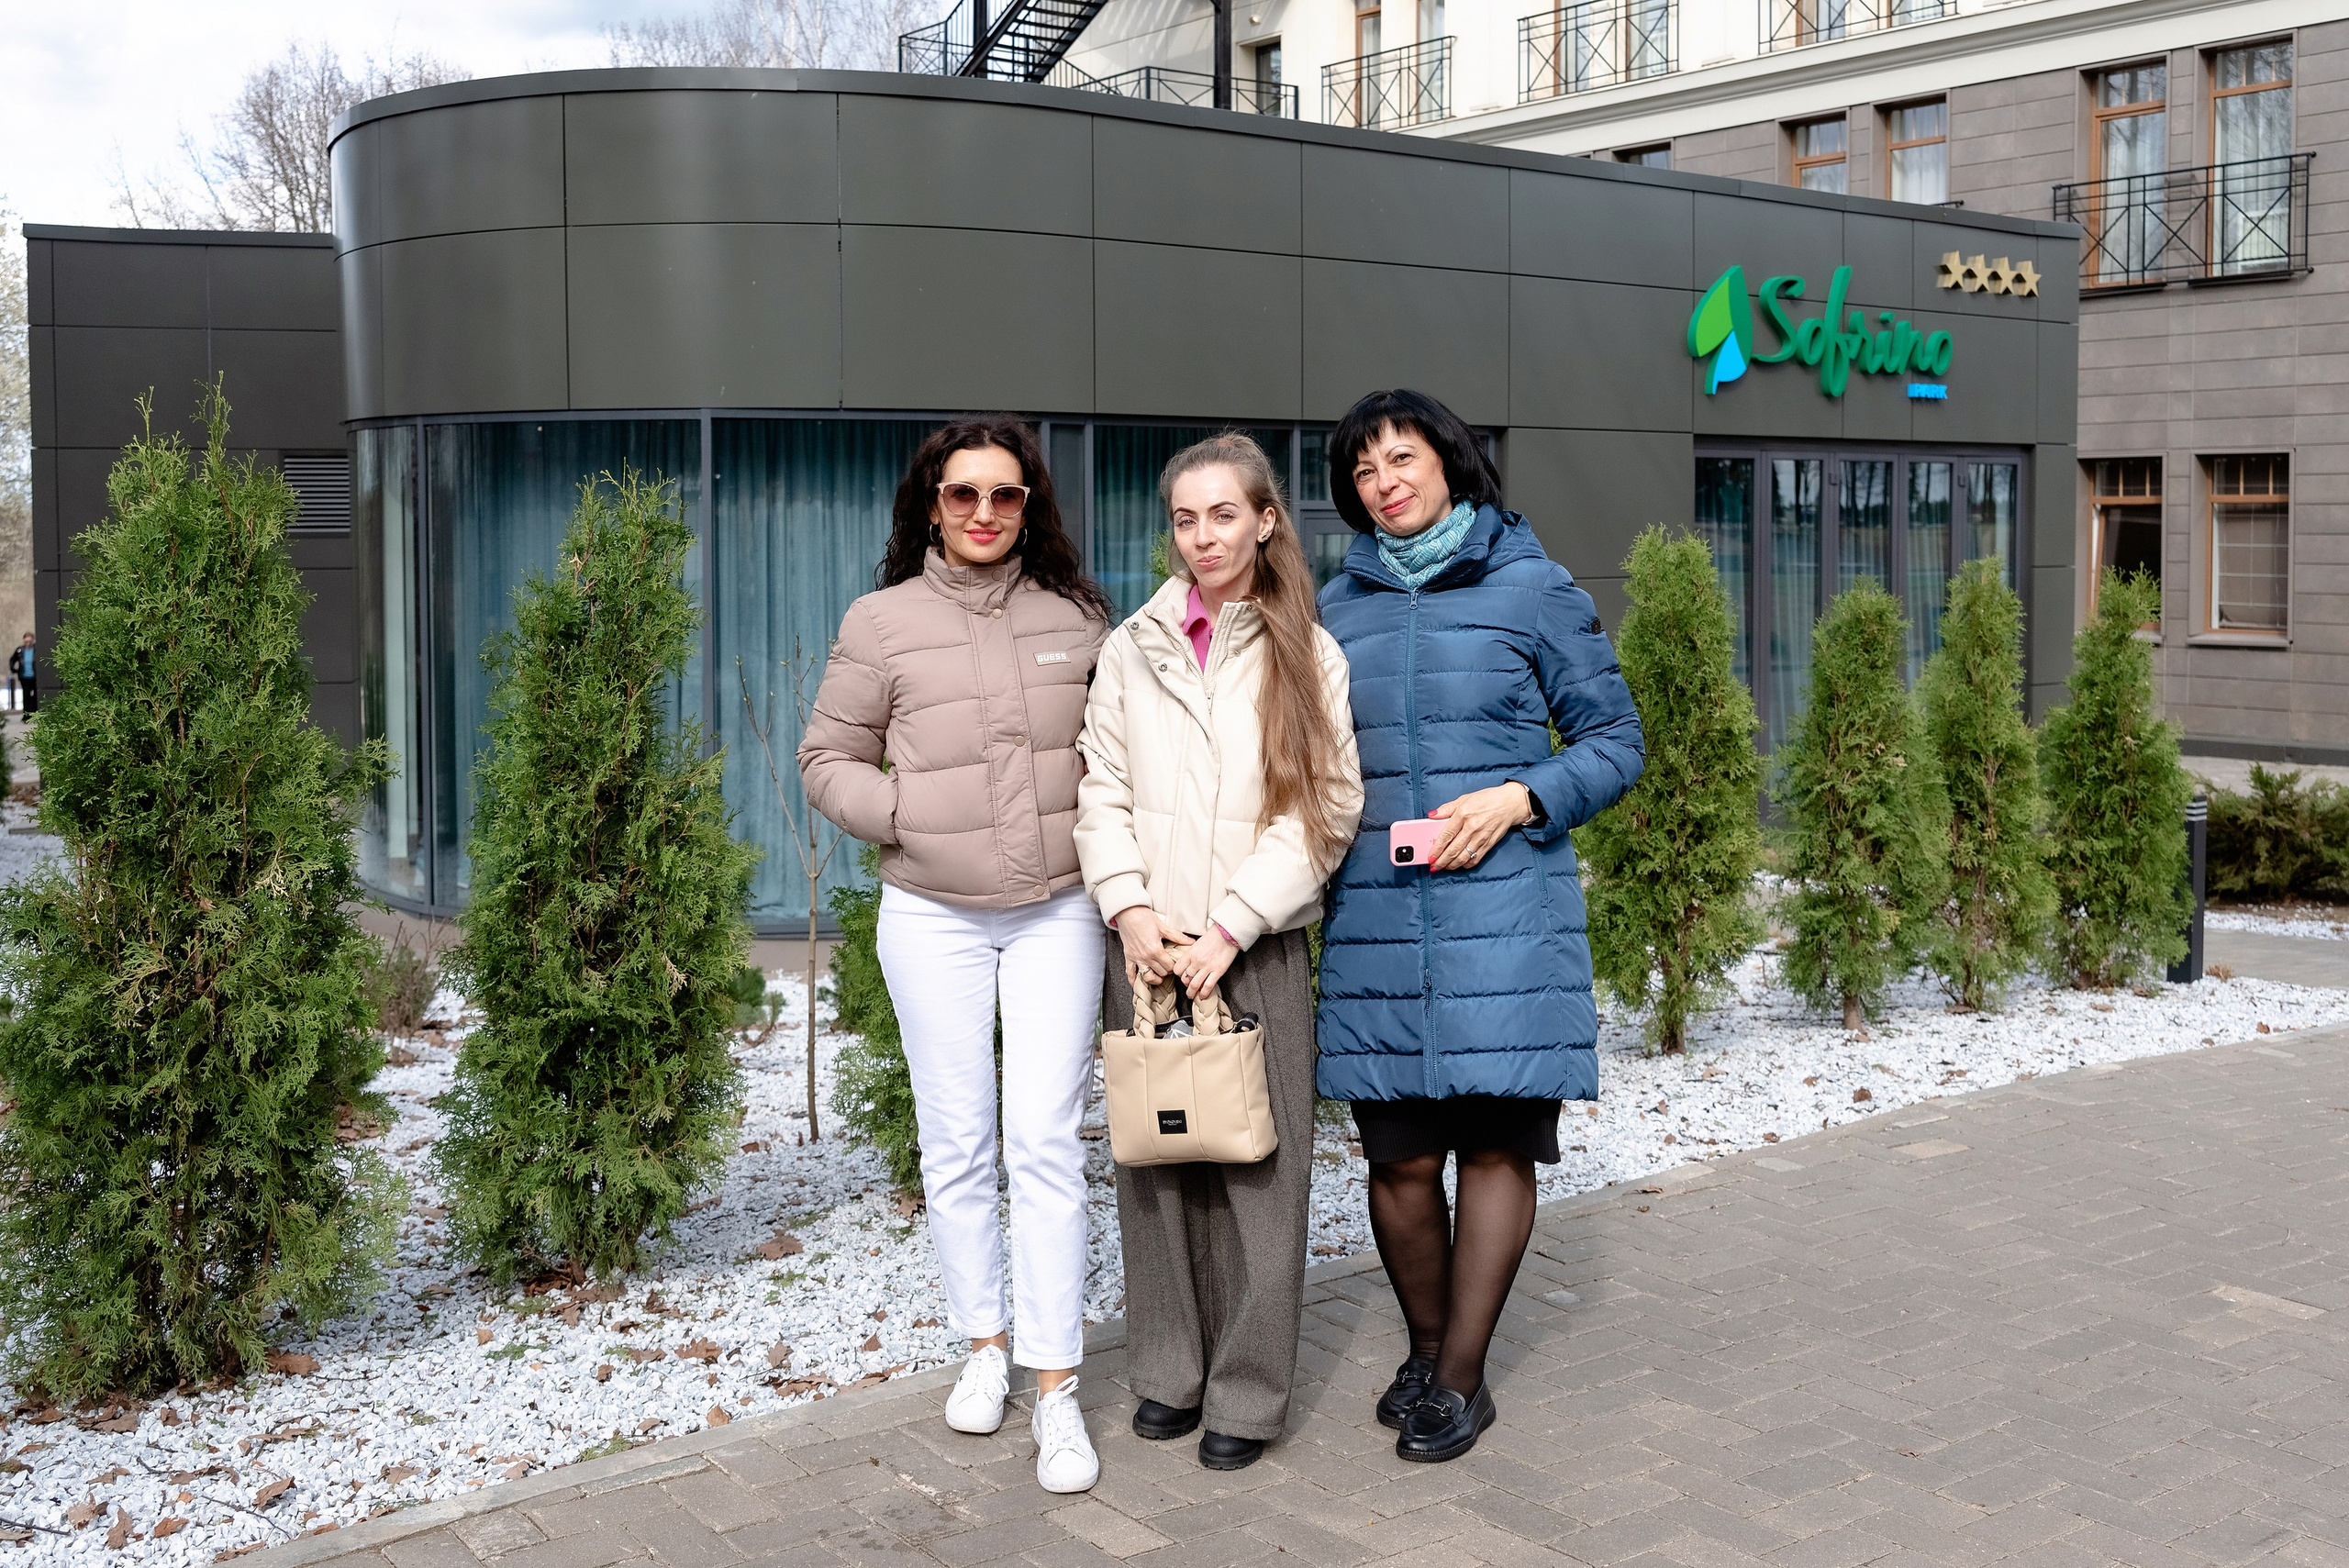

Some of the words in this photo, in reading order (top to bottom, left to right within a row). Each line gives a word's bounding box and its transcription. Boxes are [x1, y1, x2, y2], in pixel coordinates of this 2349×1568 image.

[1751, 265, 1954, 397] Sofrino
[1908, 383, 1948, 399] PARK
[1037, 652, 1067, 662] GUESS
